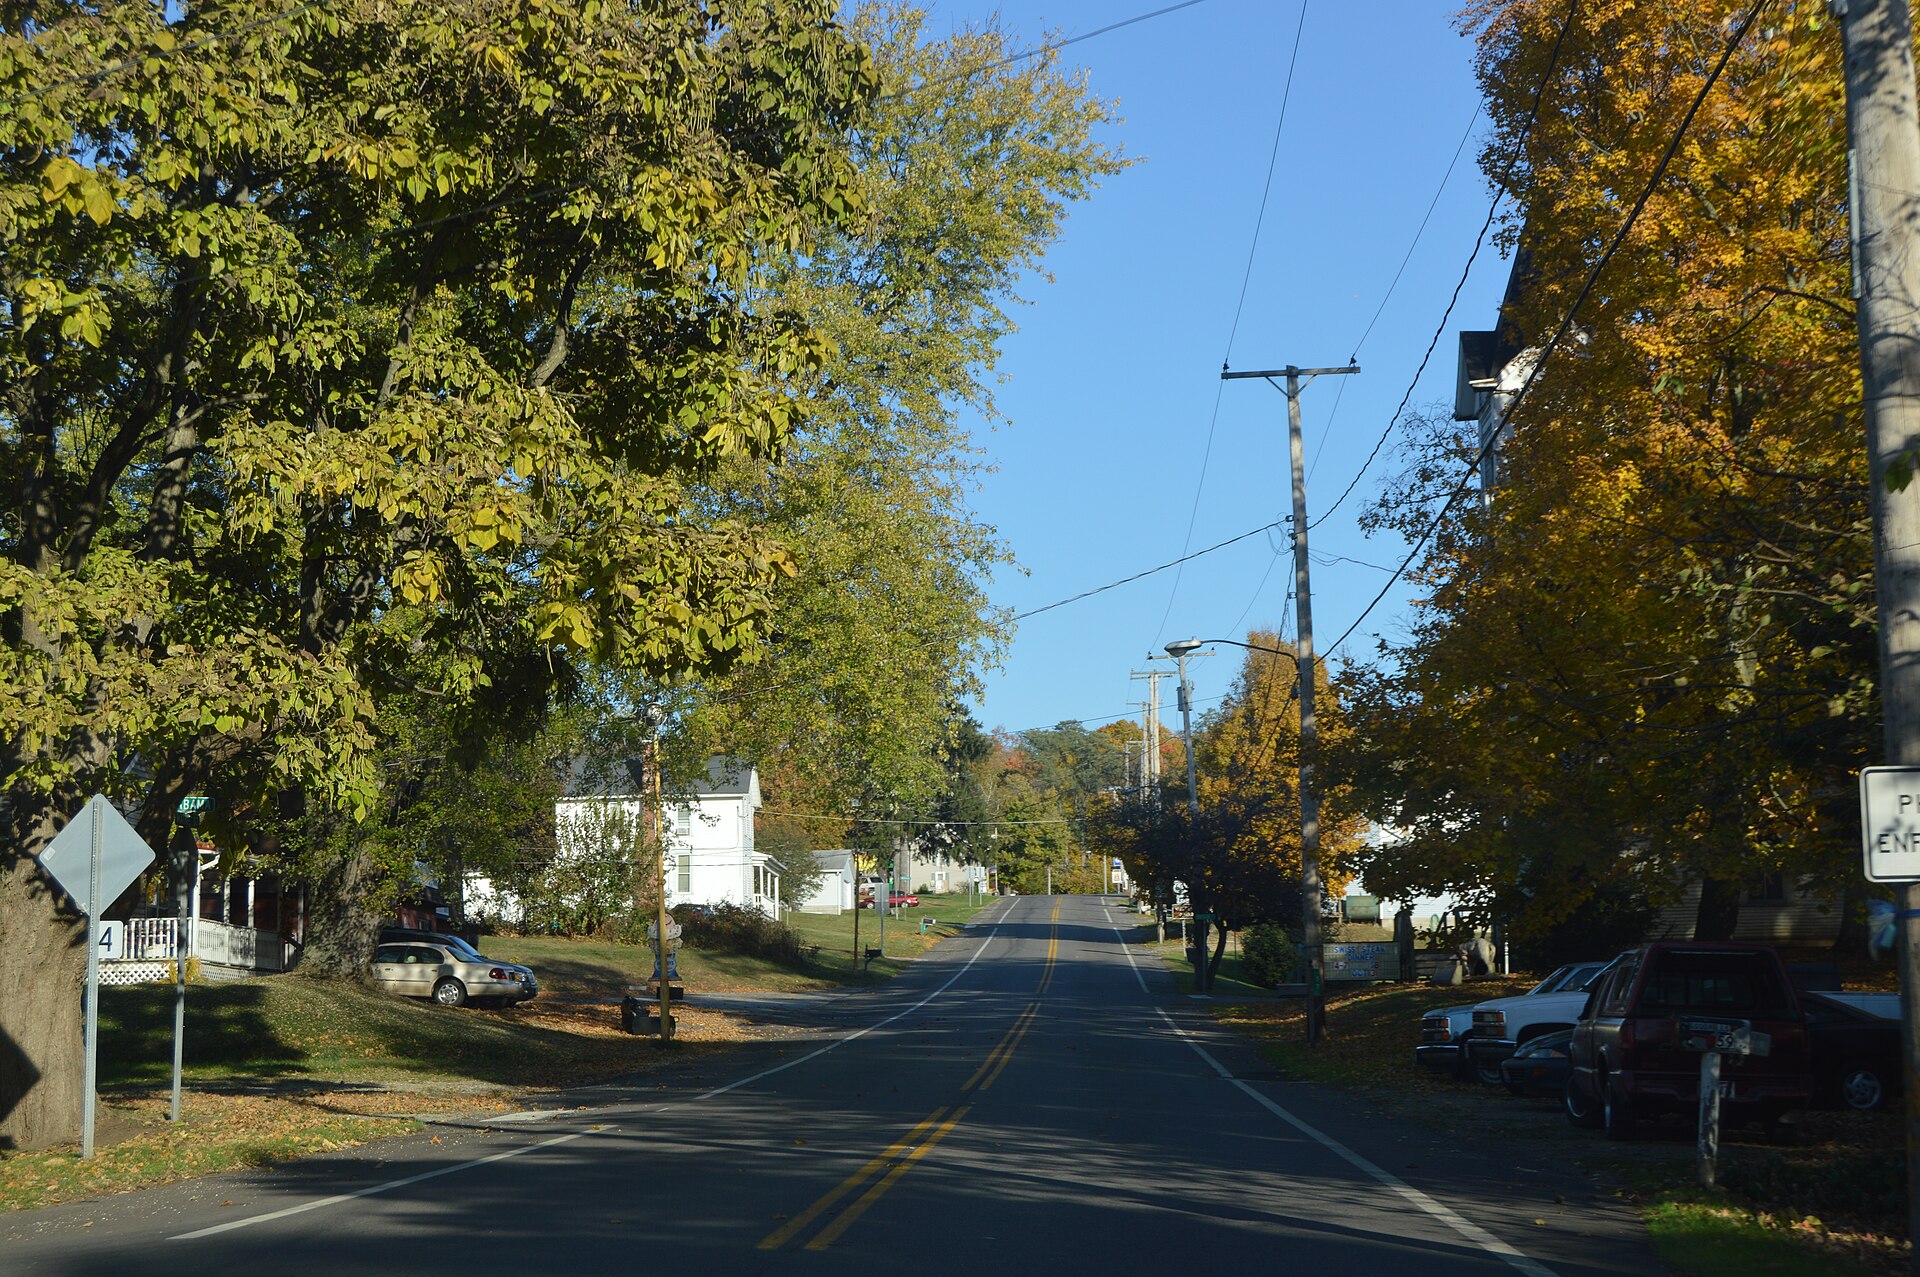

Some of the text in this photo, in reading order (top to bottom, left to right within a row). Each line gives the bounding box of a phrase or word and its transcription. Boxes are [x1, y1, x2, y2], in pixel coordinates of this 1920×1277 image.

[1333, 945, 1386, 954] SWISS STEAK
[1347, 953, 1377, 961] DINNER
[1715, 1035, 1734, 1047] 59
